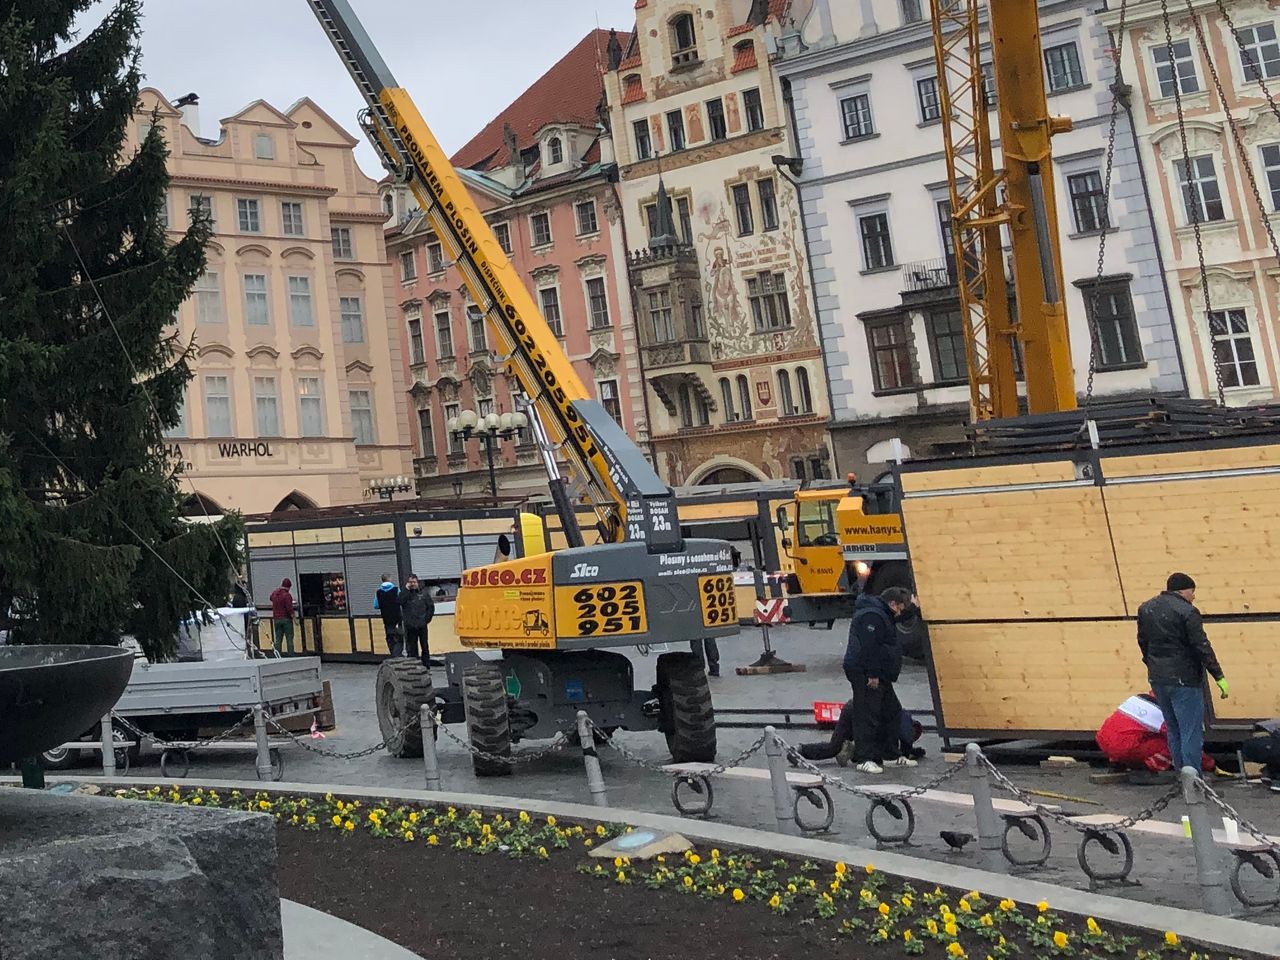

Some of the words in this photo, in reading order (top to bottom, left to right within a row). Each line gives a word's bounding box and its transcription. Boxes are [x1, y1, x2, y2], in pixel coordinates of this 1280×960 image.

[445, 201, 478, 256] PLOŠIN
[218, 442, 273, 458] WARHOL
[570, 563, 599, 578] Sico
[573, 585, 638, 603] 602
[703, 576, 734, 594] 602
[576, 600, 640, 619] 205
[706, 592, 735, 609] 205
[707, 606, 737, 624] 951
[578, 616, 641, 636] 951
